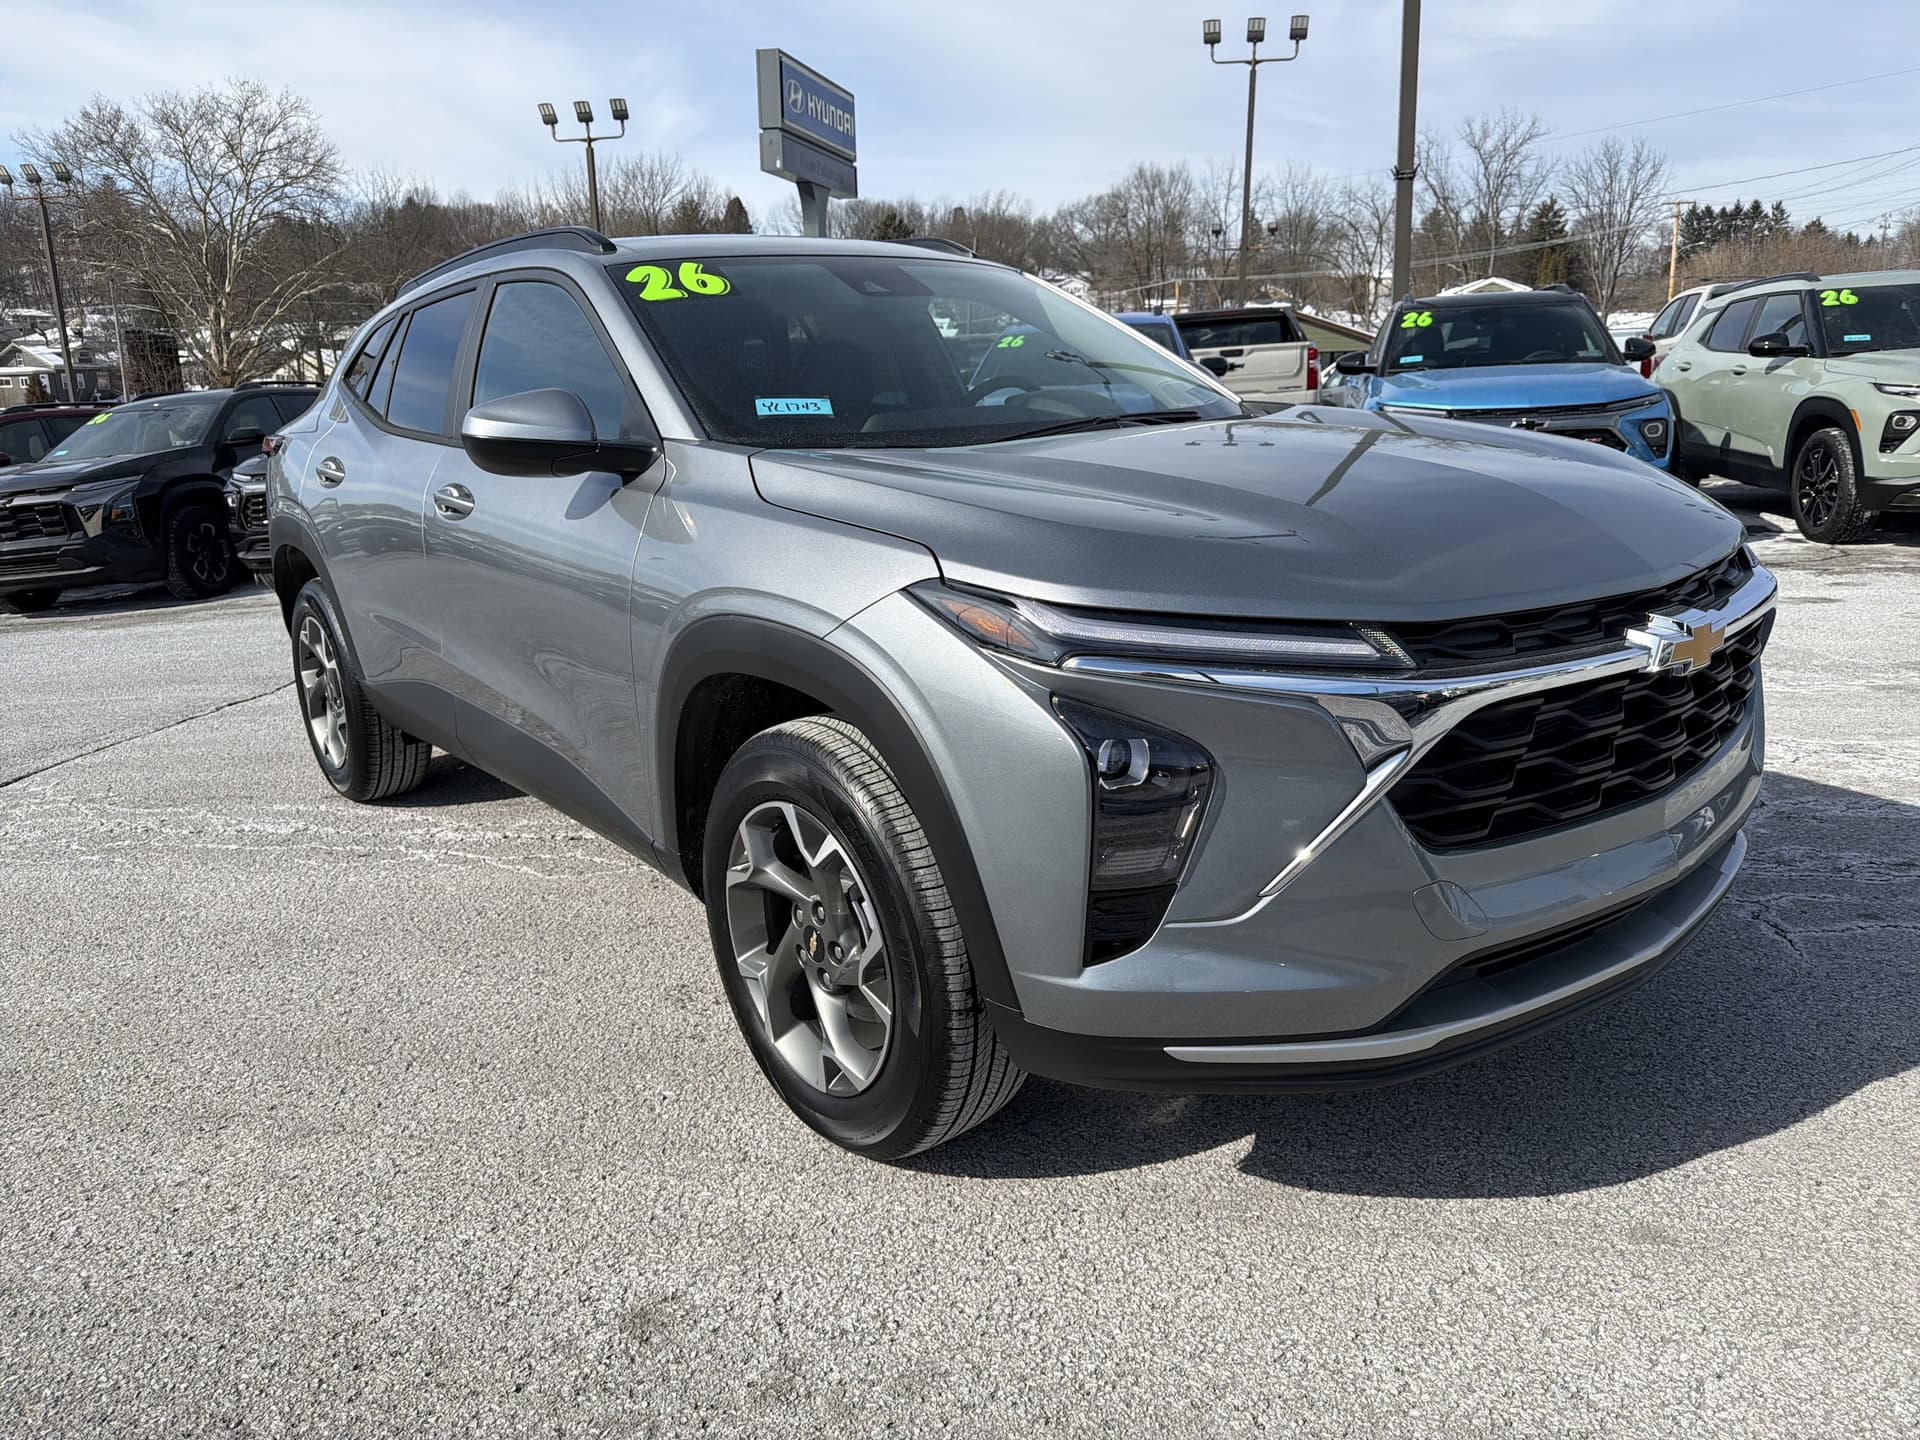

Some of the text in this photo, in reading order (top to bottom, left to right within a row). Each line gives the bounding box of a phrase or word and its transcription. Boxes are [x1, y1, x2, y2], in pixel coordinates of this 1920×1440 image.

[807, 92, 855, 137] HYUNDAI
[625, 262, 731, 301] 26
[1820, 288, 1859, 306] 26
[1400, 311, 1433, 328] 26
[997, 335, 1025, 349] 26
